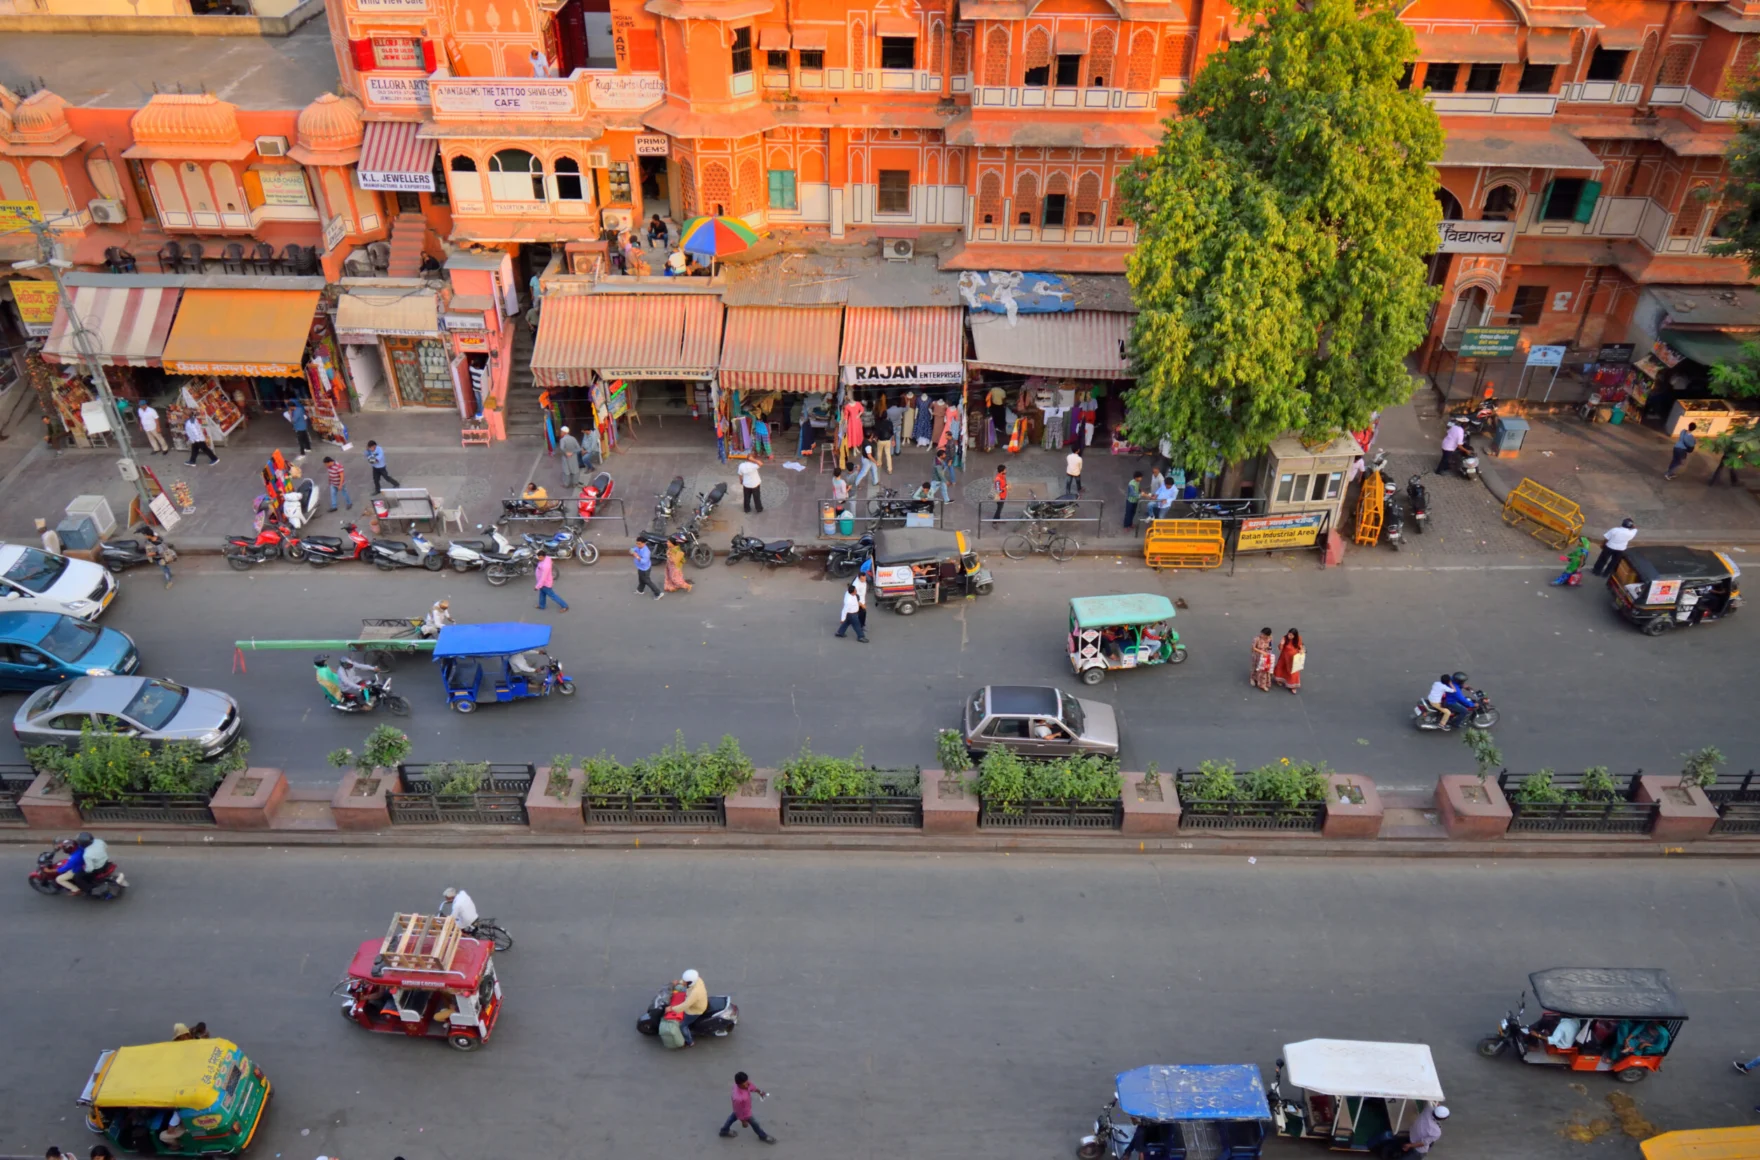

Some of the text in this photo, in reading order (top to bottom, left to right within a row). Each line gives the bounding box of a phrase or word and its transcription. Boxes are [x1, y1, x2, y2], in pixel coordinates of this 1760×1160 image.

[371, 79, 429, 91] ELLORA ARTS
[482, 87, 526, 96] THE TATTOO
[527, 87, 568, 97] SHIVA GEMS
[494, 99, 521, 107] CAFE
[361, 173, 430, 183] K.L. JEWELLERS
[1444, 228, 1505, 244] विद्यालय
[855, 365, 962, 380] RAJAN ENTERPRISES
[1263, 530, 1296, 538] Industrial
